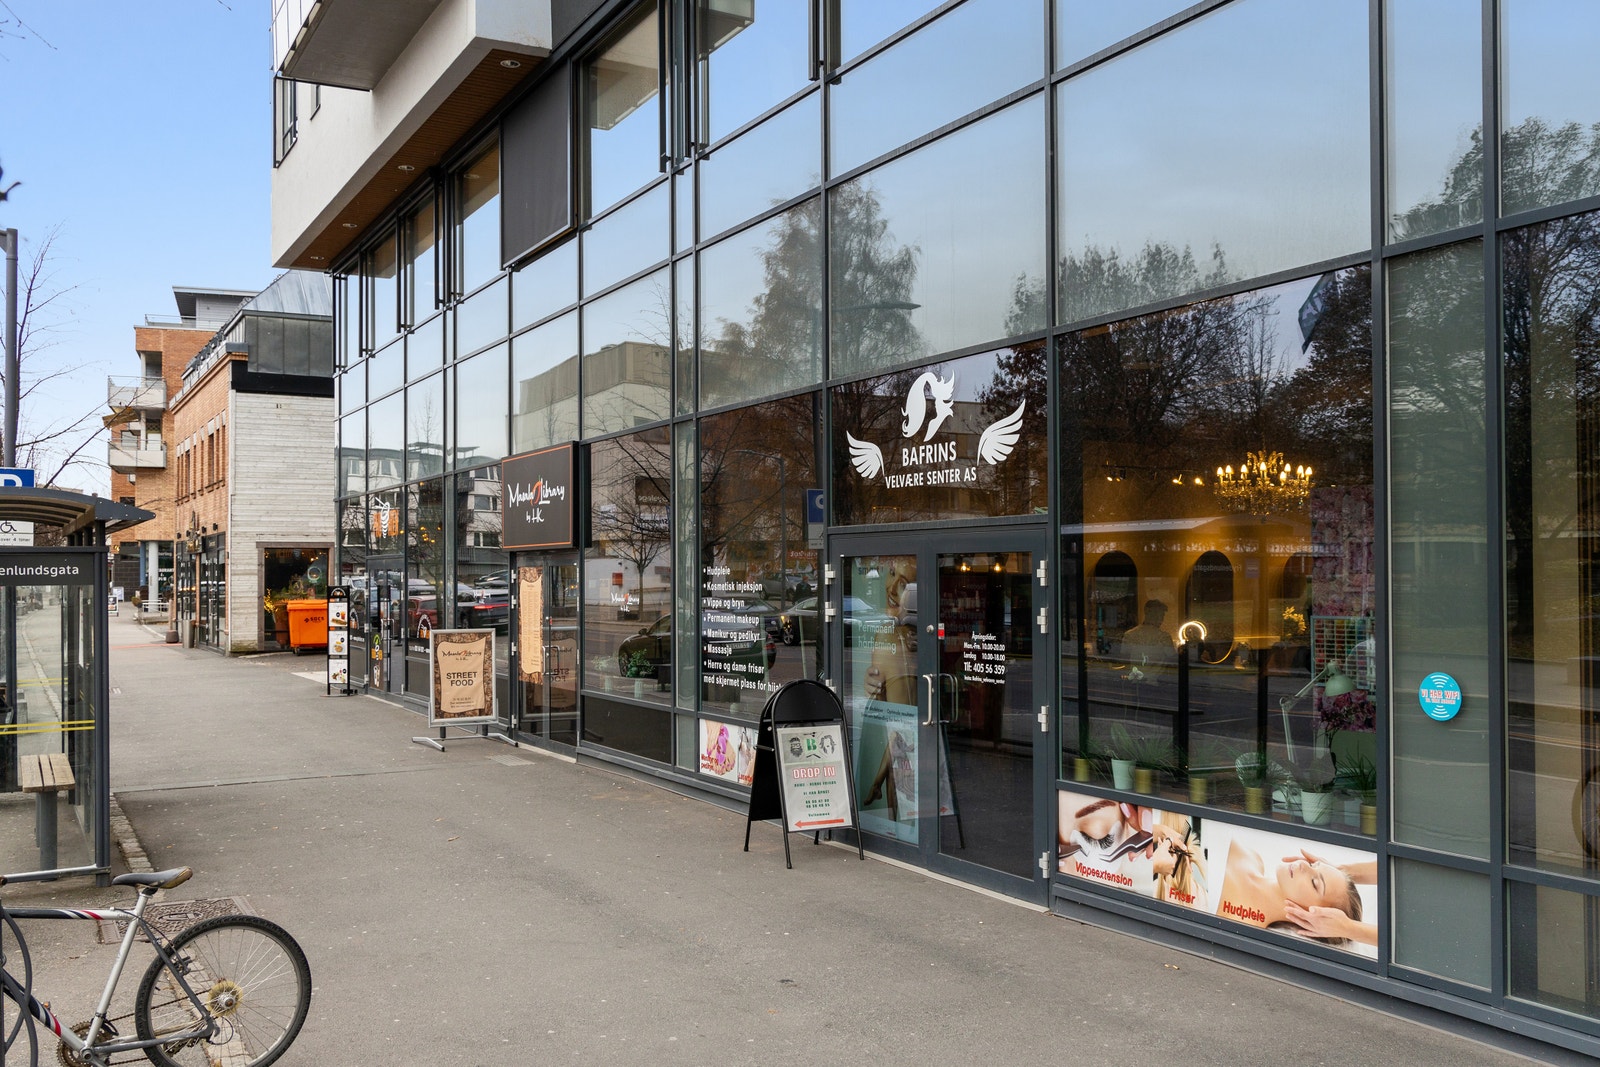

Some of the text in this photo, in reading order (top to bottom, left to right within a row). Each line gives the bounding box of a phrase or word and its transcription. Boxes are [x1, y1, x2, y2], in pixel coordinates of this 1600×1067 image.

[902, 440, 957, 467] BAFRINS
[885, 466, 977, 489] VELVÆRE SENTER AS
[706, 566, 730, 577] Hudpleie
[706, 582, 762, 593] Kosmetisk injeksjon
[706, 598, 745, 609] Vippe og bryn
[707, 613, 760, 626] Permanent makeup
[858, 622, 895, 634] Permanent
[730, 632, 737, 642] og
[738, 631, 760, 642] pedikyr
[707, 644, 732, 656] Massasje
[707, 660, 722, 669] Herre
[723, 662, 730, 672] og
[732, 661, 746, 672] dame
[973, 663, 984, 673] 405
[985, 664, 993, 674] 56
[994, 664, 1005, 675] 359
[704, 675, 714, 684] med
[716, 676, 739, 687] skjermet
[740, 679, 756, 690] plass
[757, 680, 766, 690] for
[792, 766, 836, 779] DROP IN
[1075, 861, 1133, 887] Vippeextension
[1223, 900, 1265, 923] Hudpleie
